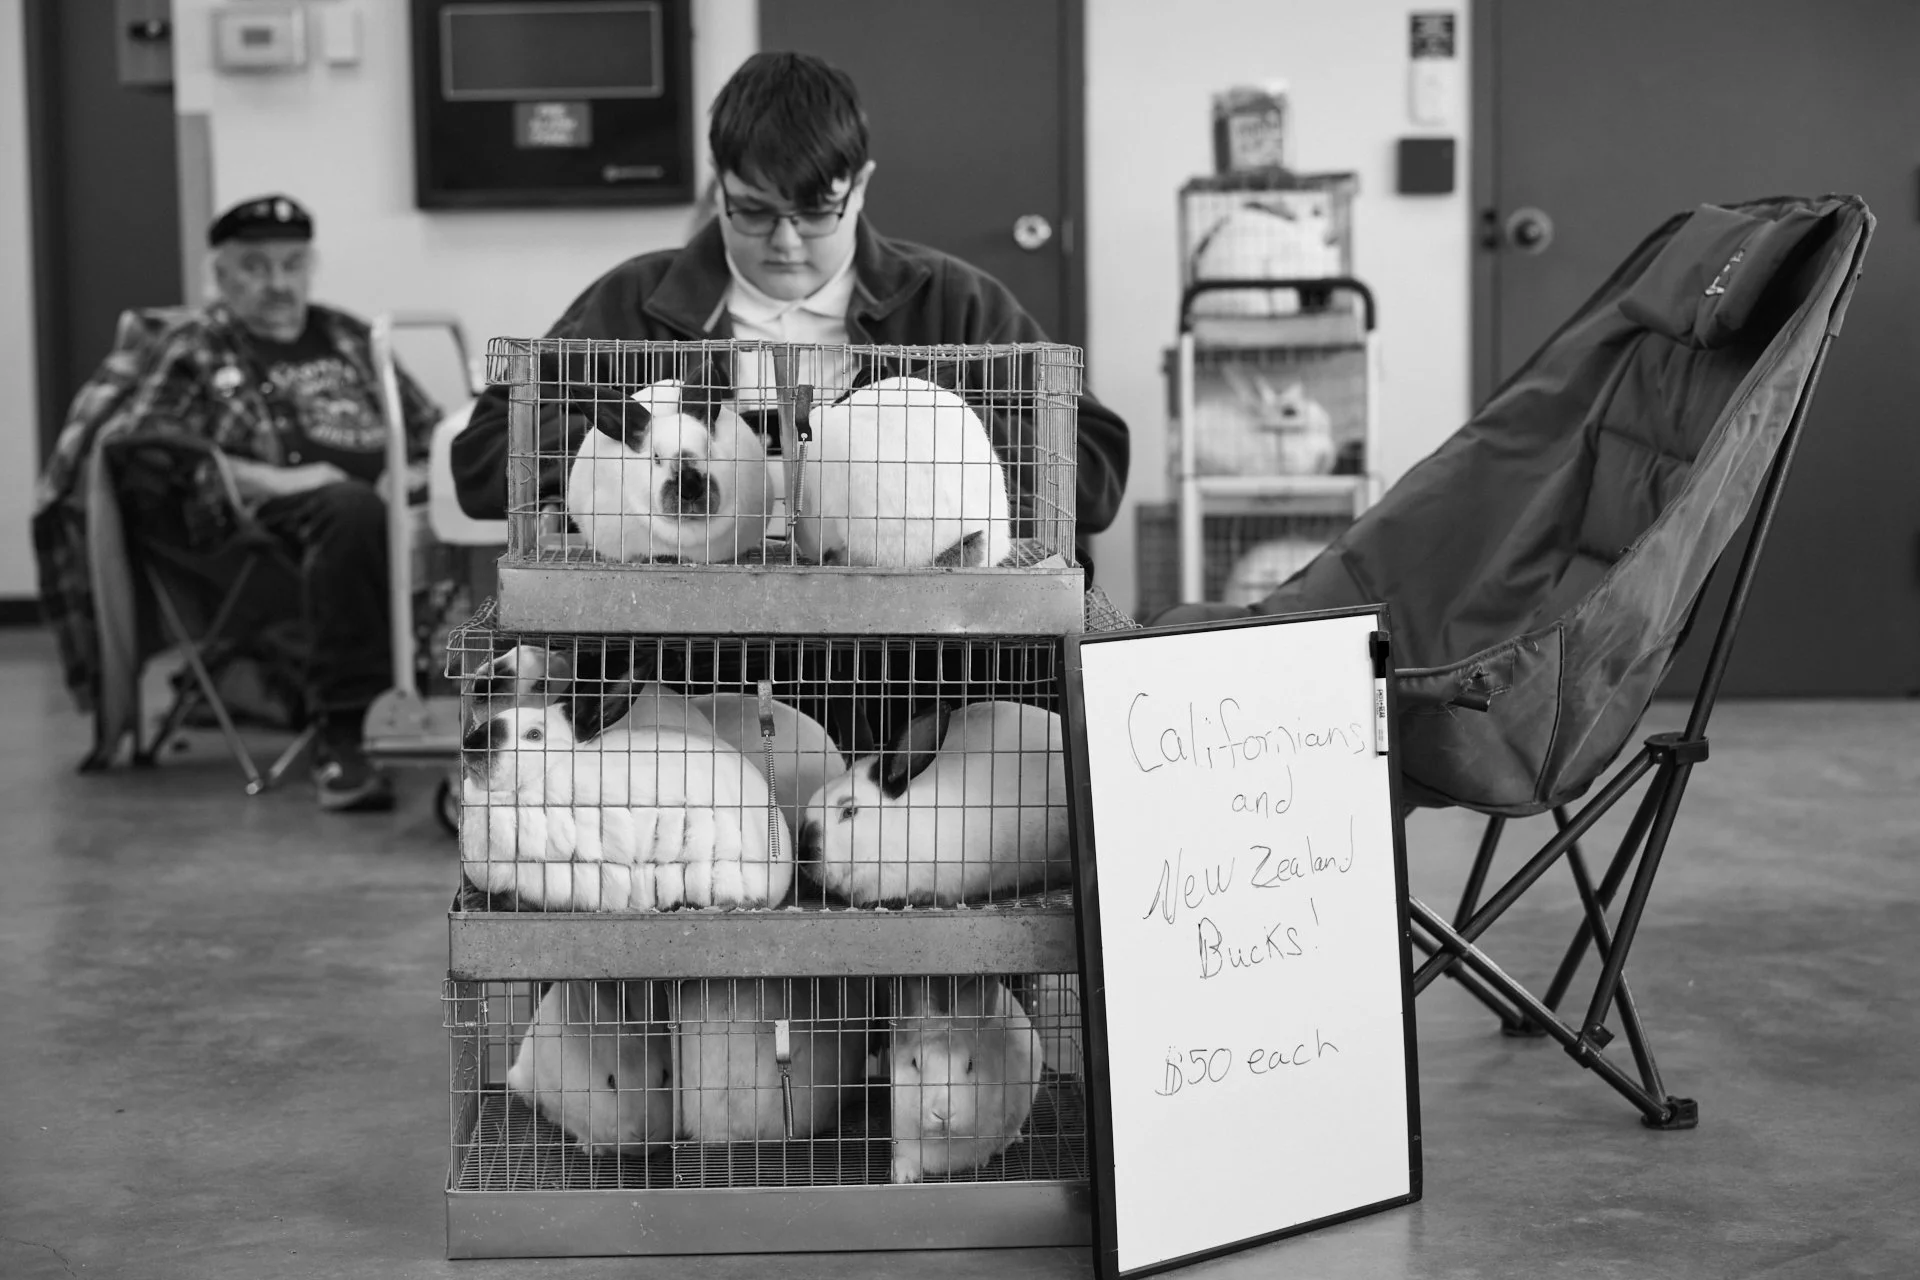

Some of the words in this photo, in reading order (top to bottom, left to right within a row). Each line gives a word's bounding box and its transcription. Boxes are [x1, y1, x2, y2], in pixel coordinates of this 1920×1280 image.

[1127, 692, 1366, 773] Californians
[1231, 764, 1293, 819] and
[1142, 847, 1235, 925] New
[1249, 814, 1354, 889] Zealand
[1154, 1045, 1233, 1097] $50
[1246, 1028, 1340, 1075] each
